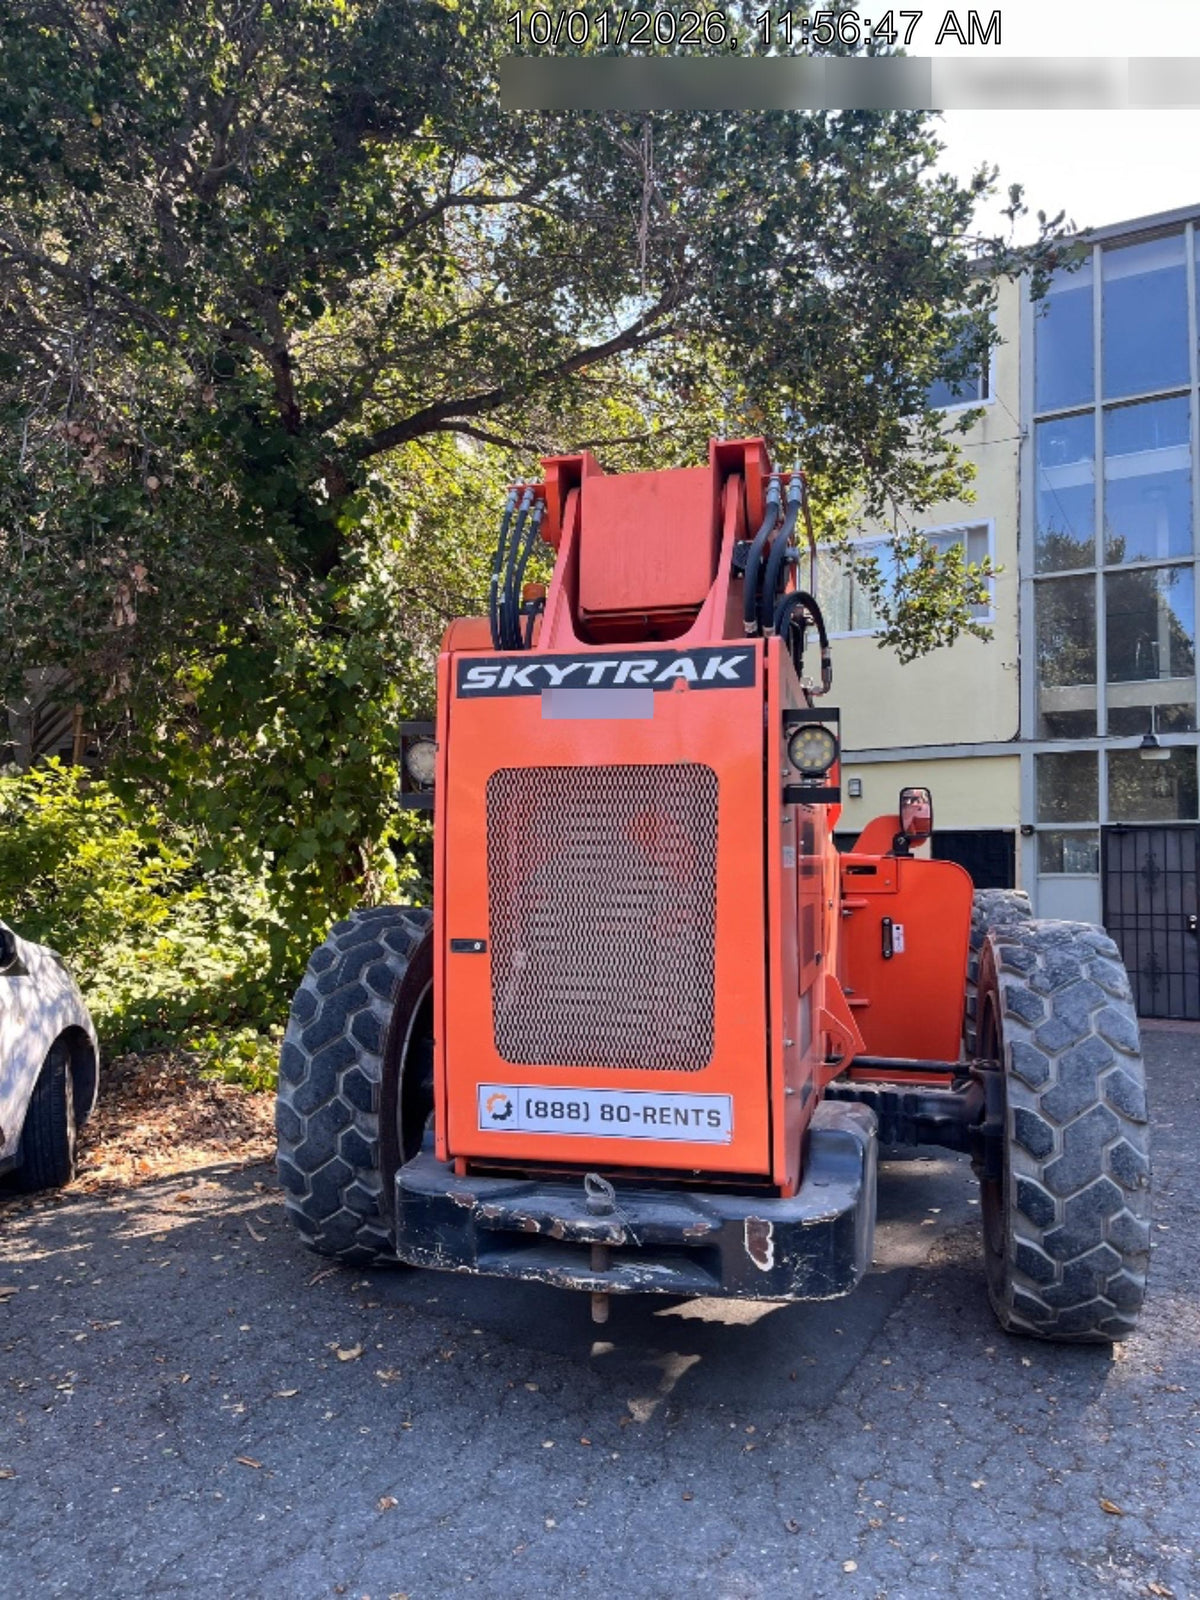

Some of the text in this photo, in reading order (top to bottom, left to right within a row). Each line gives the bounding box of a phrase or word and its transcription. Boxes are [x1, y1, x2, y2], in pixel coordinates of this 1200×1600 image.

[461, 654, 748, 690] SKYTRAK
[525, 1098, 722, 1128] (888) 80-RENTS
